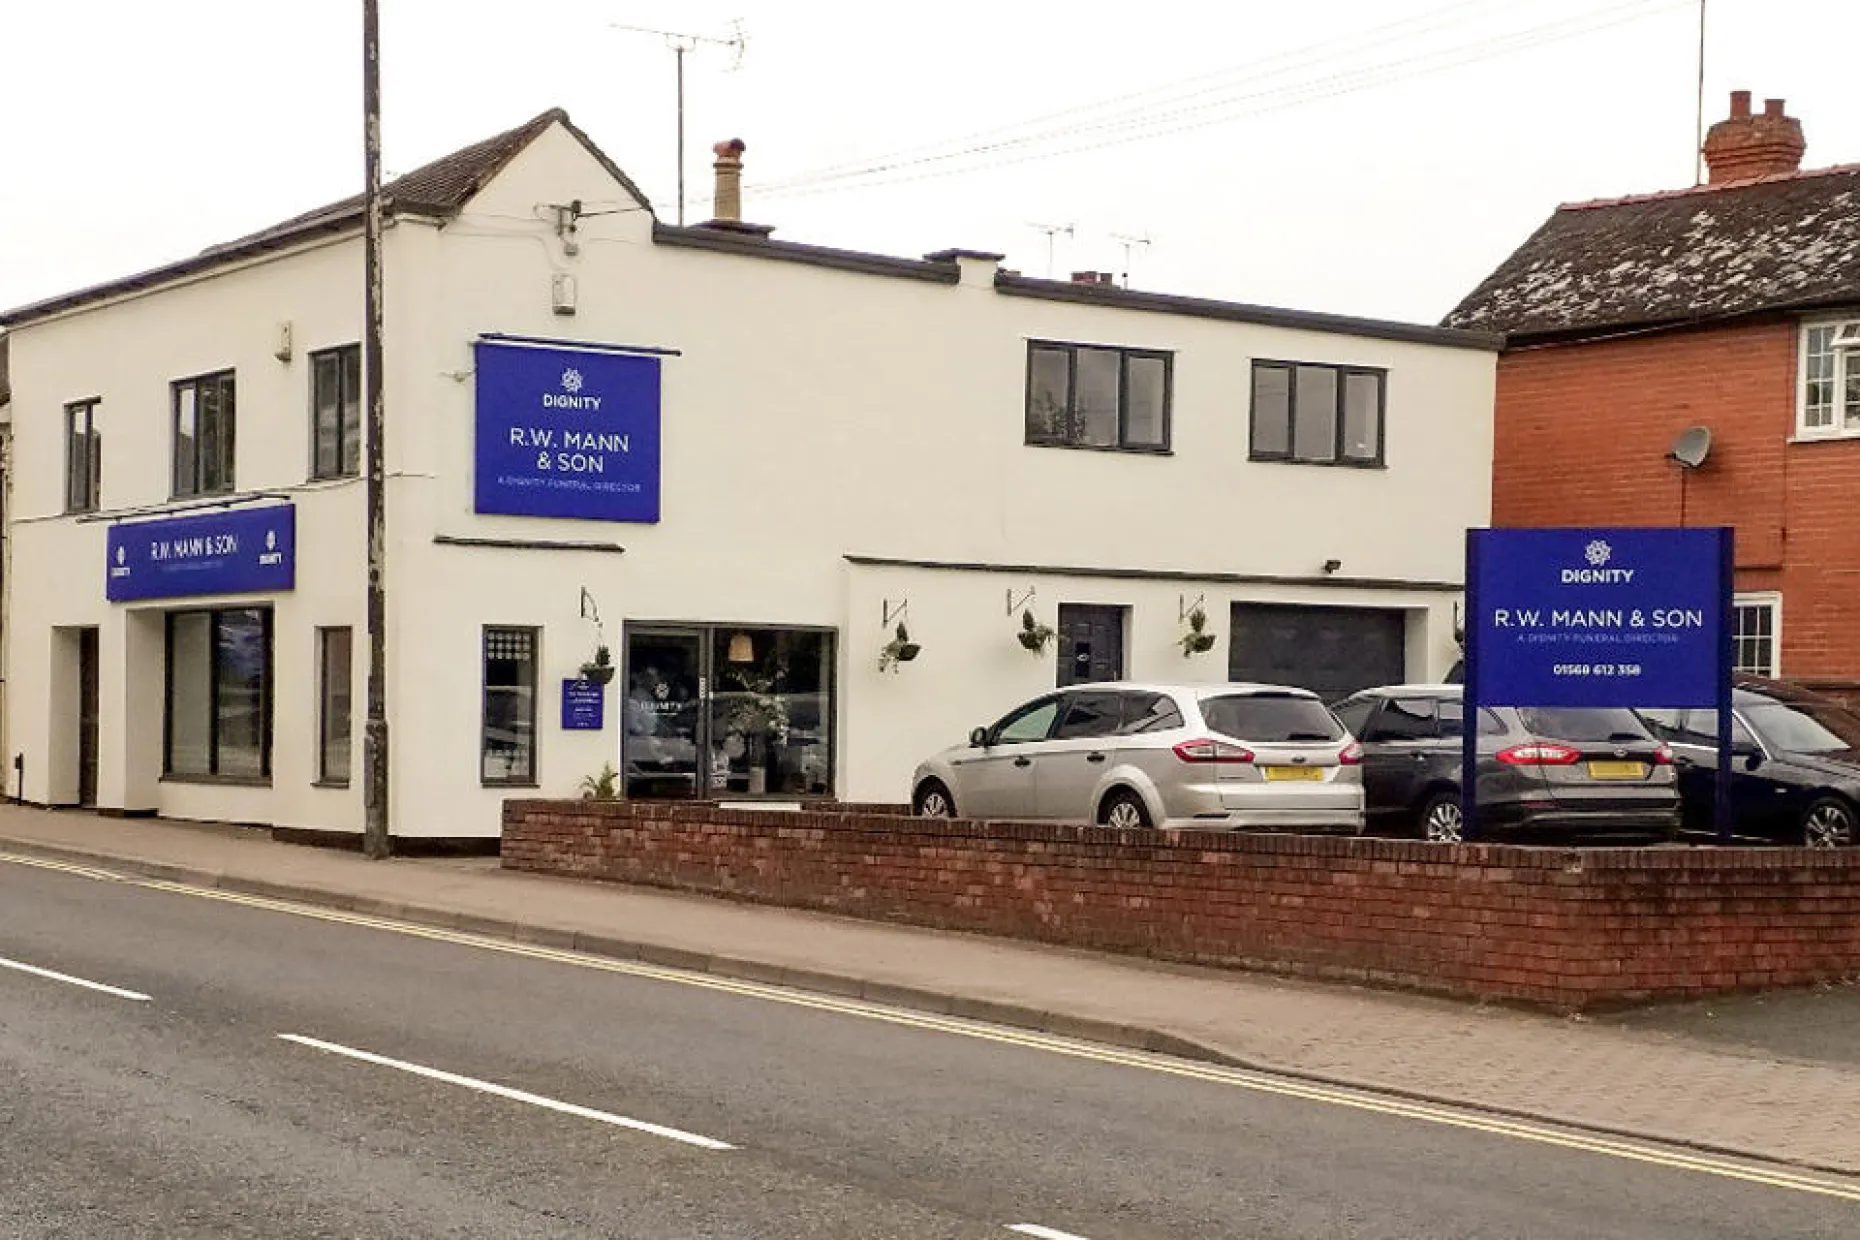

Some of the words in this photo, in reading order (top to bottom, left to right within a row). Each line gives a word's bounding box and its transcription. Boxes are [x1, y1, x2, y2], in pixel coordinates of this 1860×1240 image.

[543, 394, 602, 410] DIGNITY
[510, 427, 558, 448] R.W.
[564, 431, 630, 452] MANN
[537, 451, 551, 470] &
[557, 453, 605, 474] SON
[173, 536, 203, 559] MANN
[215, 534, 238, 554] SON
[1561, 568, 1635, 584] DIGNITY
[1494, 608, 1545, 628] R.W.
[1551, 608, 1623, 628] MANN
[1629, 608, 1645, 628] &
[1652, 608, 1703, 628] SON
[1592, 663, 1615, 676] 612
